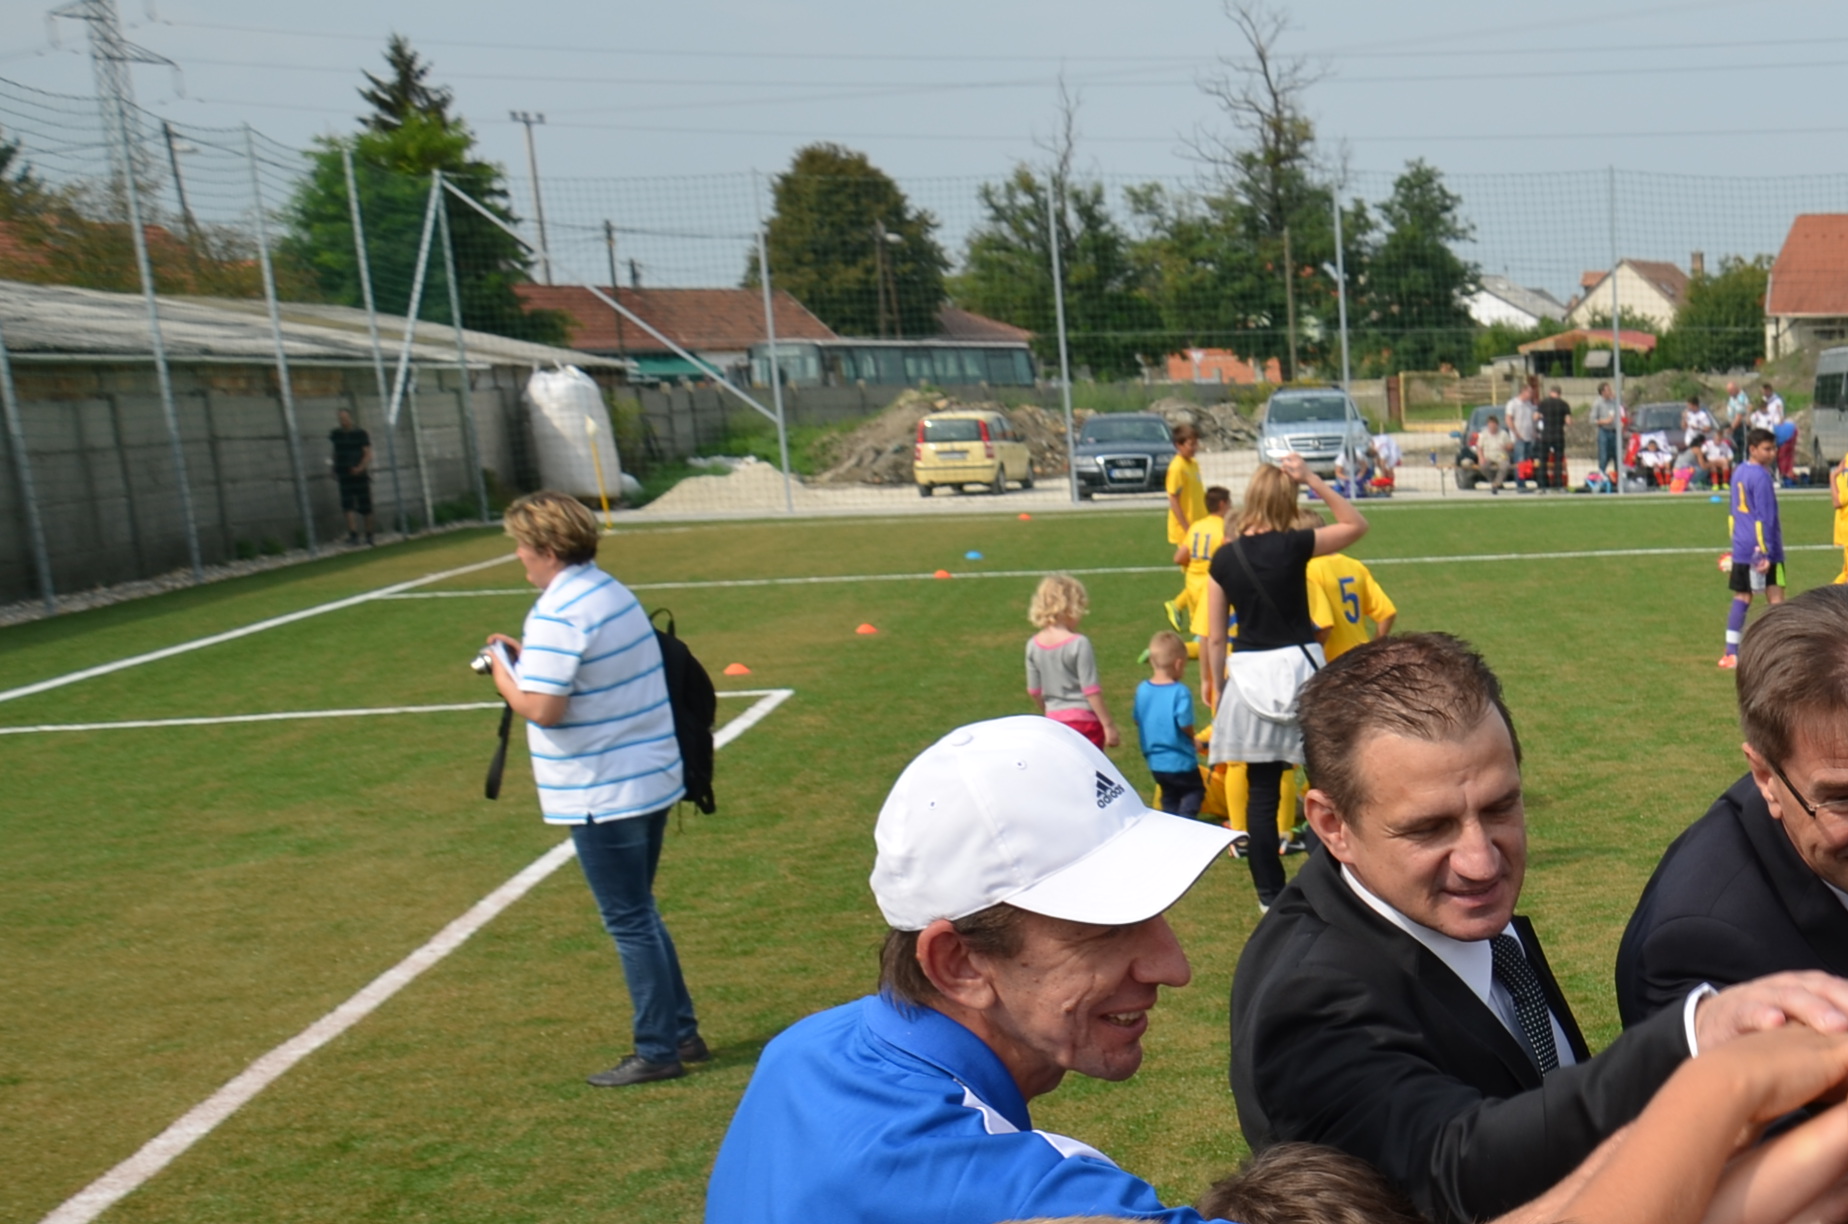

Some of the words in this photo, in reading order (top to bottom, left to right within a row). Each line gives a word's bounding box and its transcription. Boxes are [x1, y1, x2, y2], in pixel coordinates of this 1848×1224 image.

[1737, 481, 1750, 513] 1
[1191, 532, 1212, 561] 11
[1338, 576, 1360, 625] 5
[1097, 784, 1125, 808] adidas
